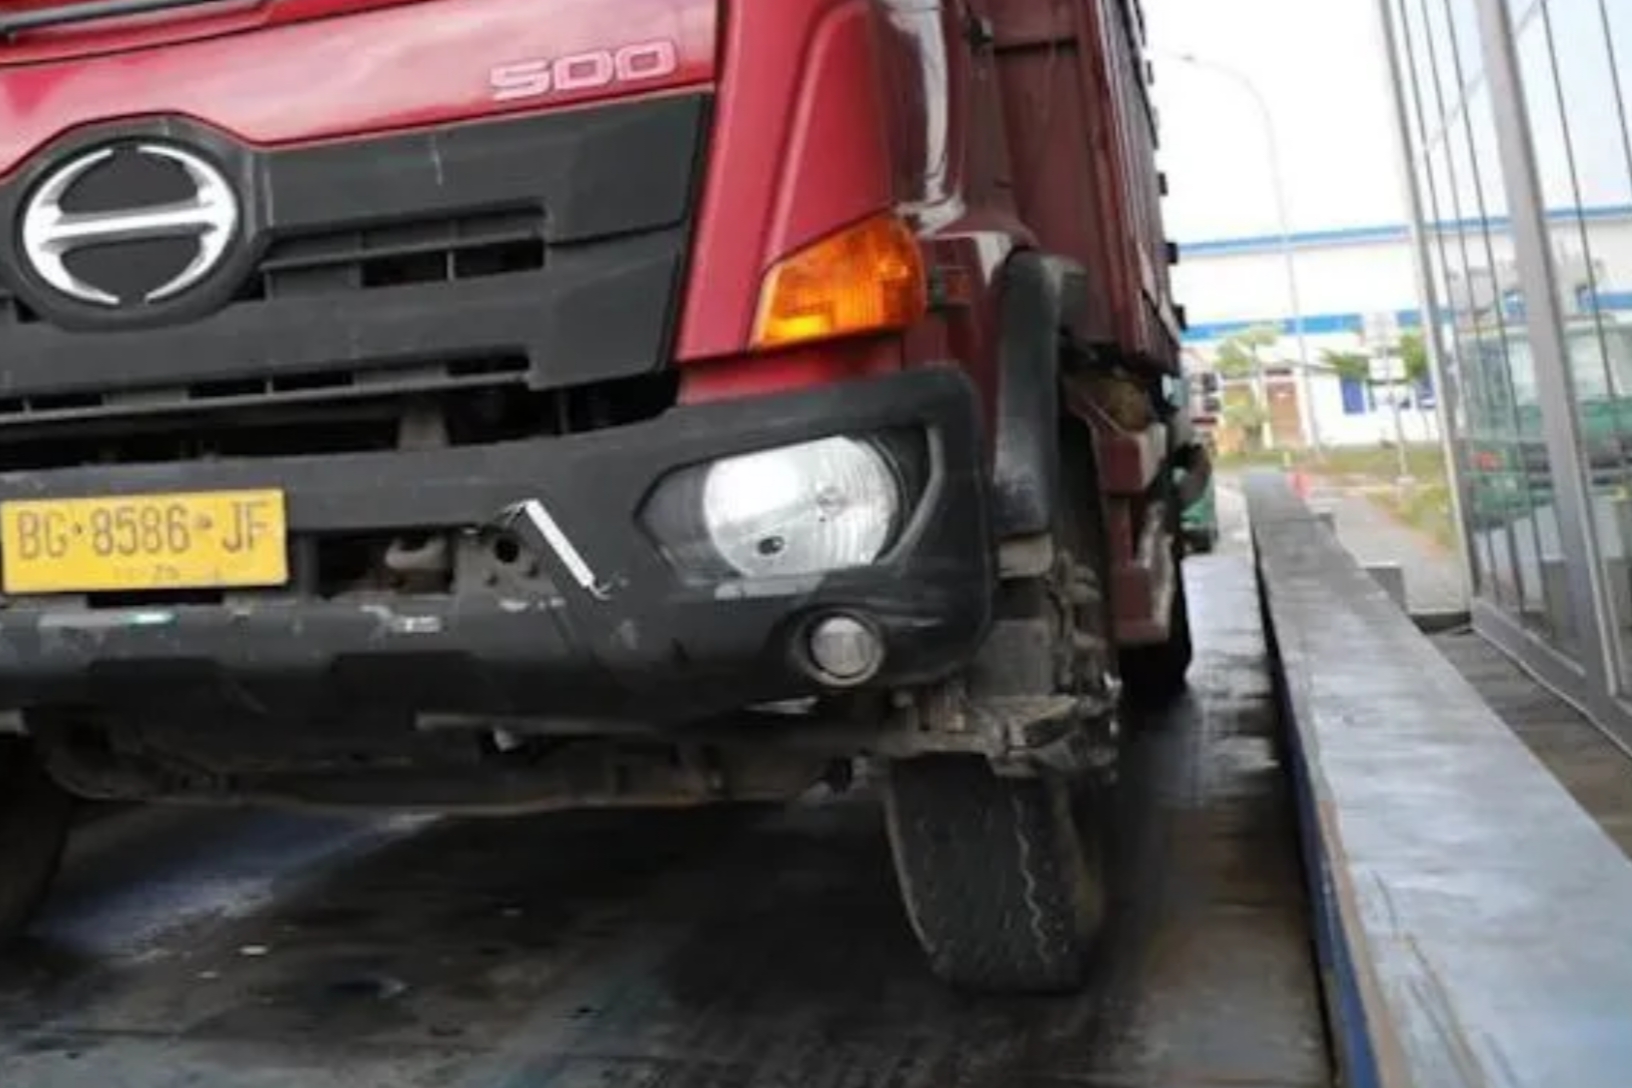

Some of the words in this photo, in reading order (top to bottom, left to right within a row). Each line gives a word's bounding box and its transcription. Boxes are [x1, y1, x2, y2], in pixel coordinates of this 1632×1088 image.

[490, 41, 676, 100] 500
[18, 511, 67, 560] BG
[90, 504, 190, 556] 8586
[222, 500, 269, 553] JF
